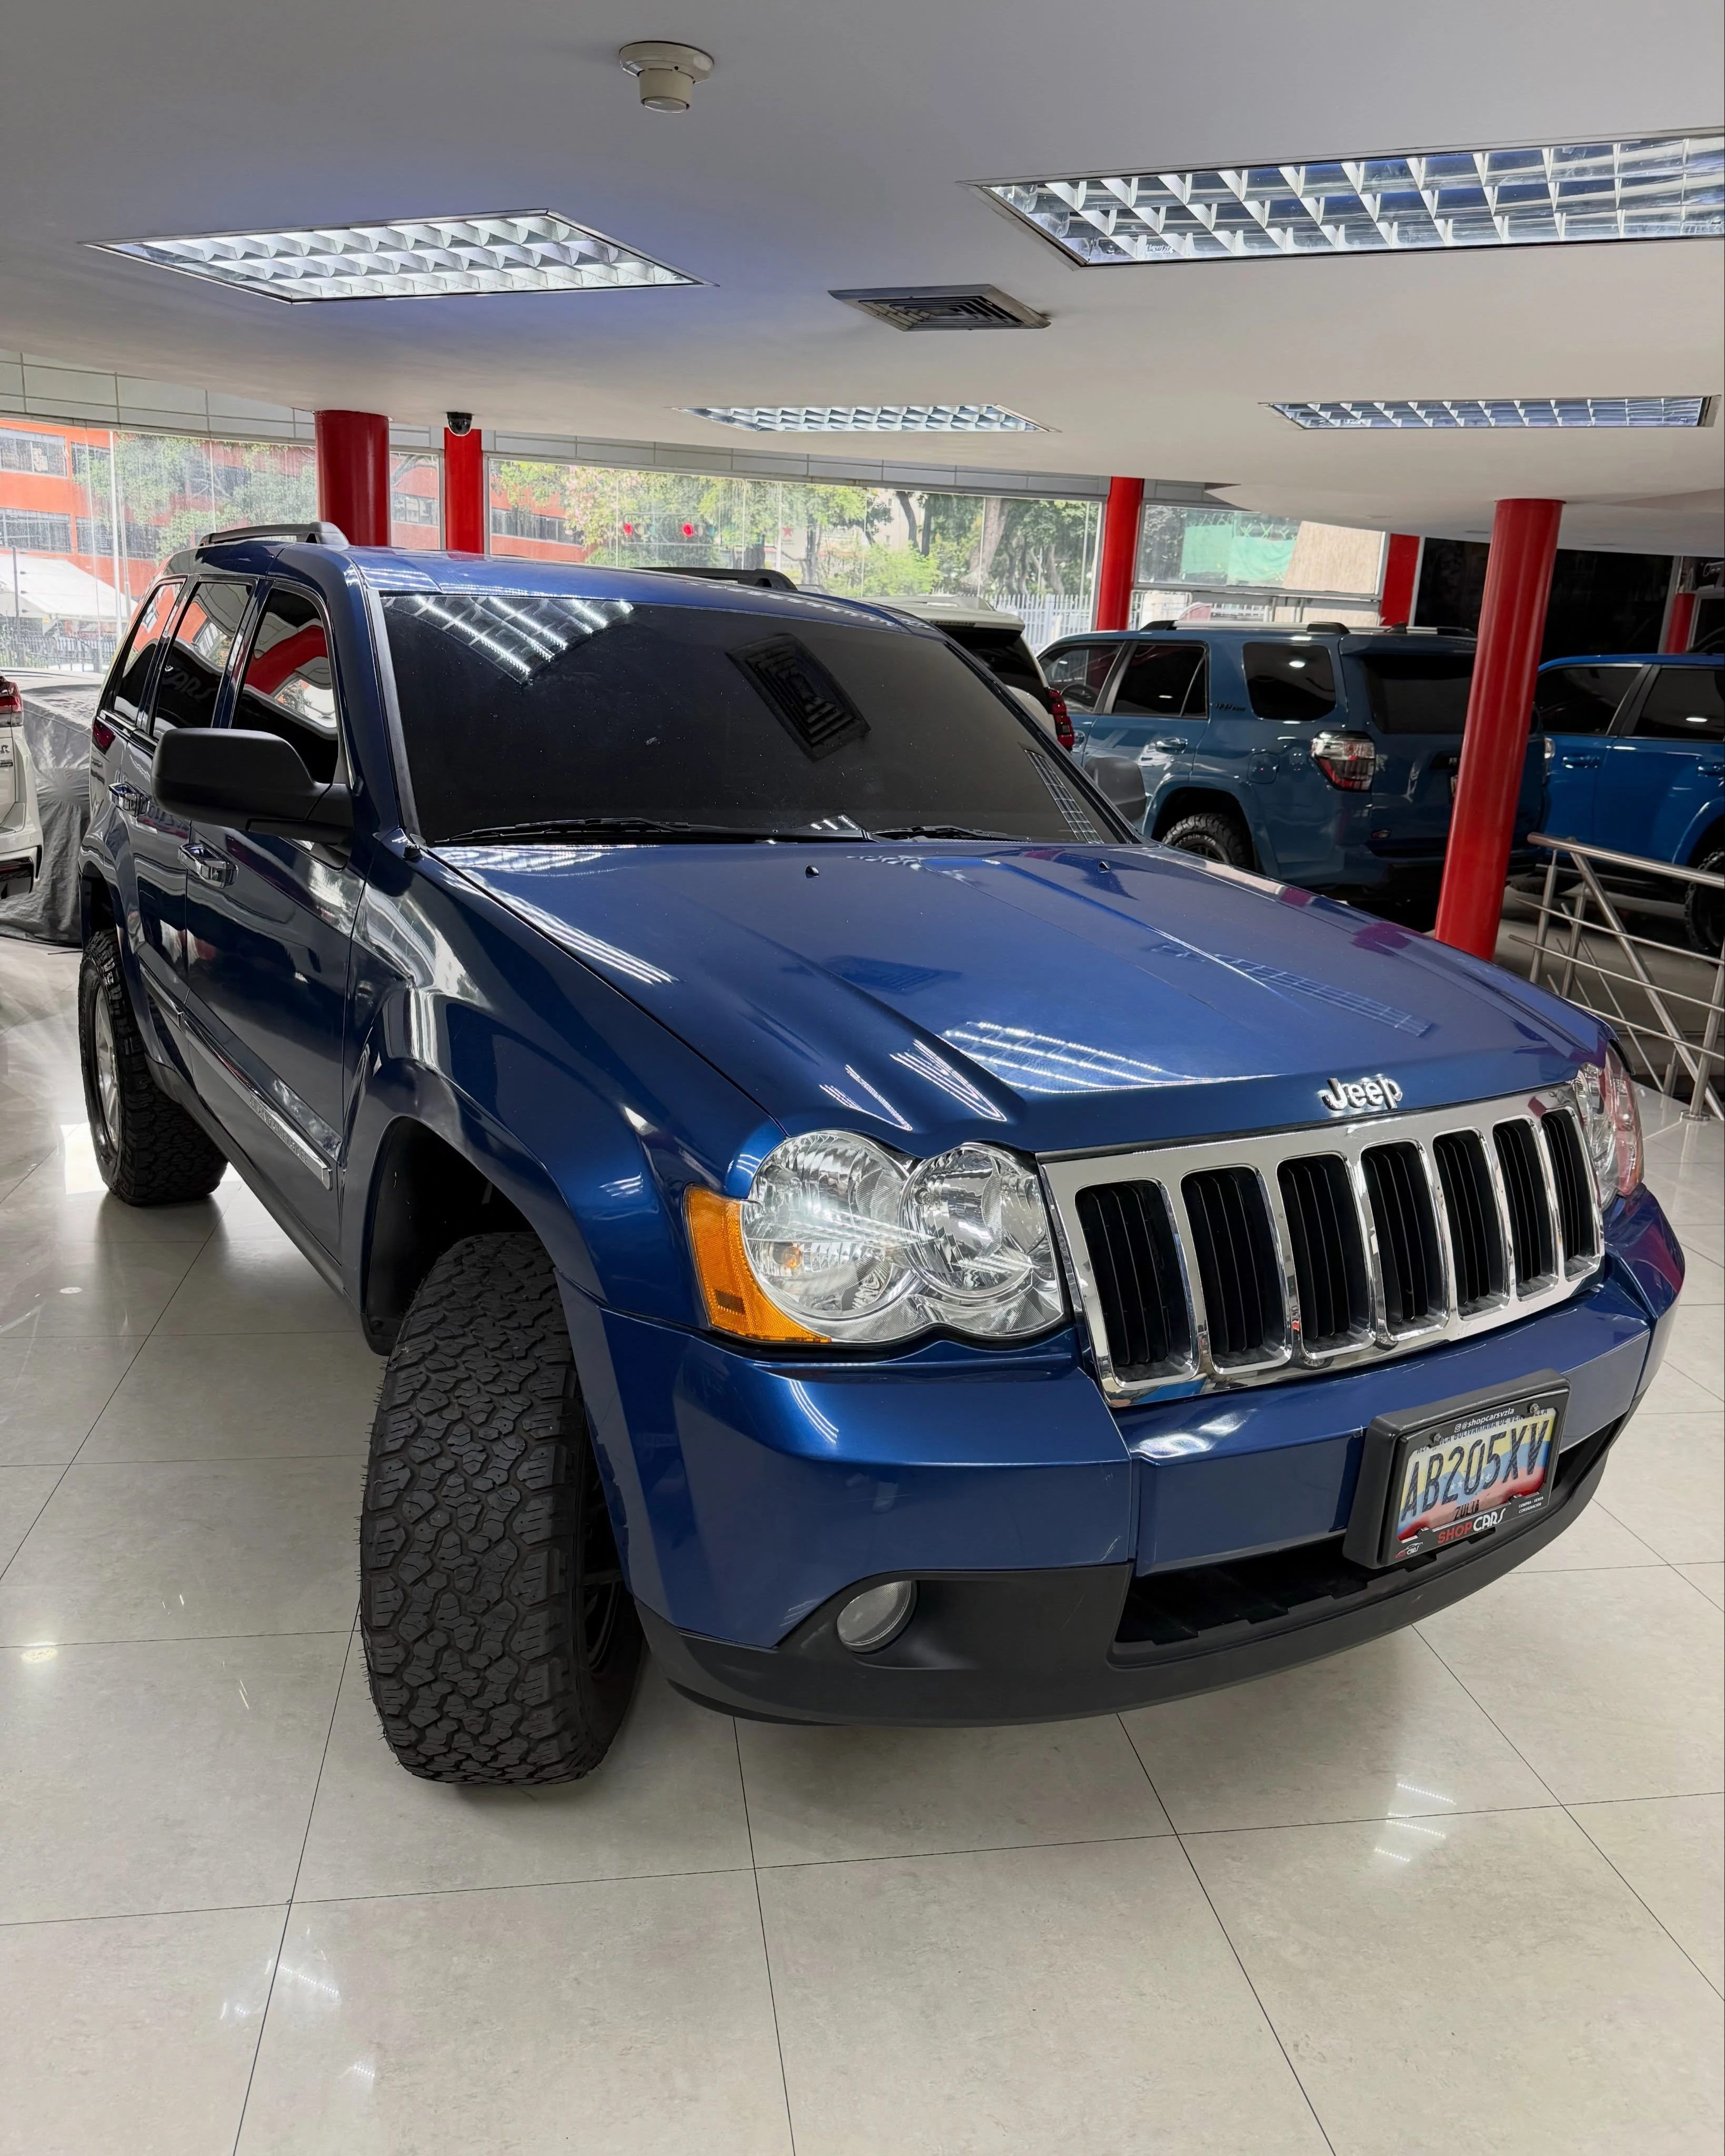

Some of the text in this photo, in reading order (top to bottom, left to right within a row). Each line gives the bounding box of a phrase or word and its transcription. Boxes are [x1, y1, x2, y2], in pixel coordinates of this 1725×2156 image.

[1322, 1078, 1403, 1110] Jeep
[1461, 1408, 1515, 1430] @shopcarsvzla
[1401, 1420, 1549, 1522] AB205XV
[1454, 1500, 1480, 1520] ZULIA
